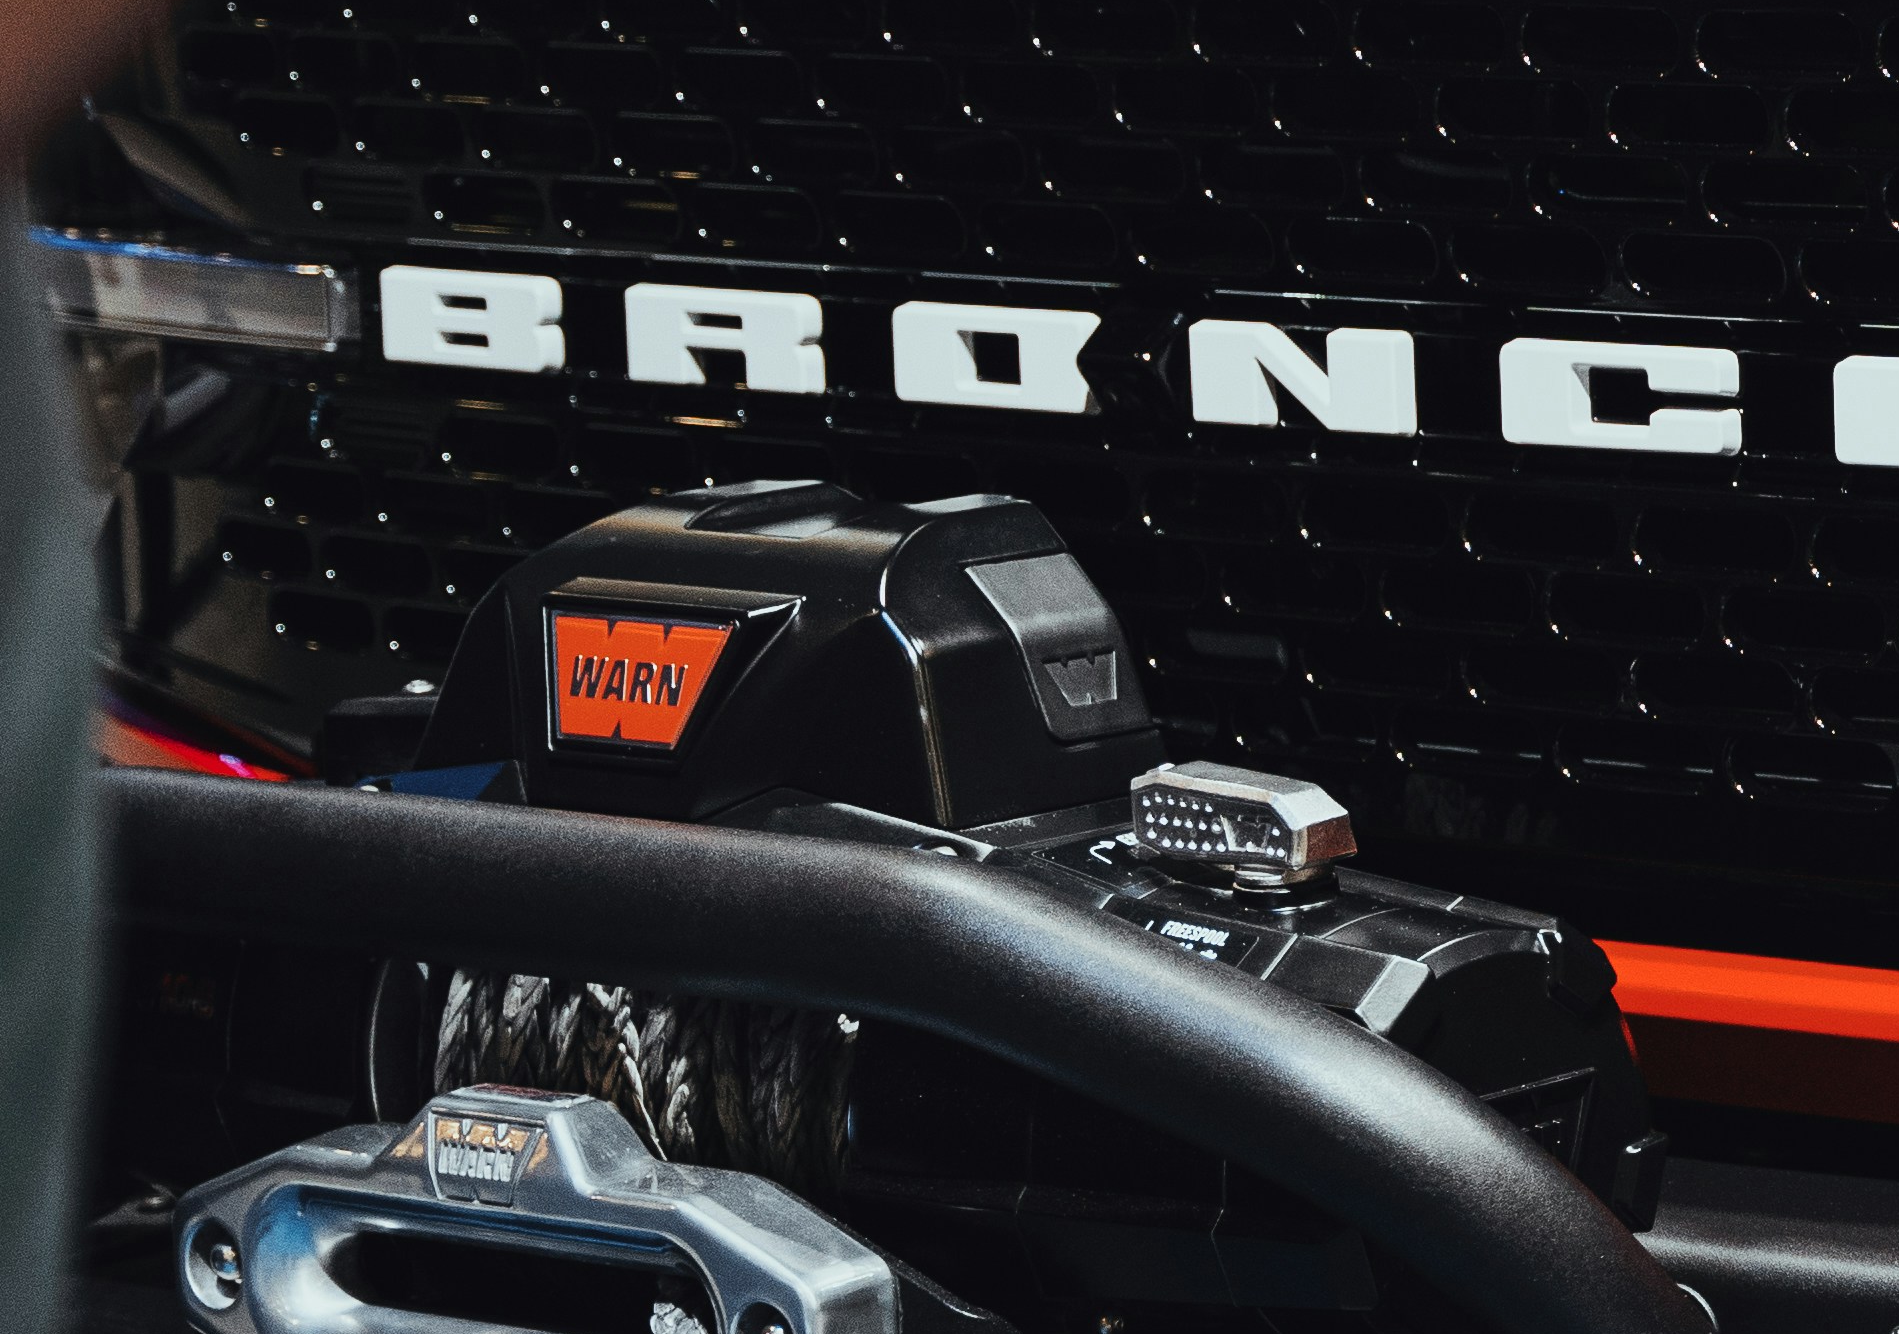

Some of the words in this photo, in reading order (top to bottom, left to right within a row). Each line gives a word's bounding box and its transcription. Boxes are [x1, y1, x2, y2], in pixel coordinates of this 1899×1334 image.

[570, 654, 688, 707] WARN
[1159, 919, 1231, 948] FREESPOOL
[437, 1138, 516, 1182] WARN
